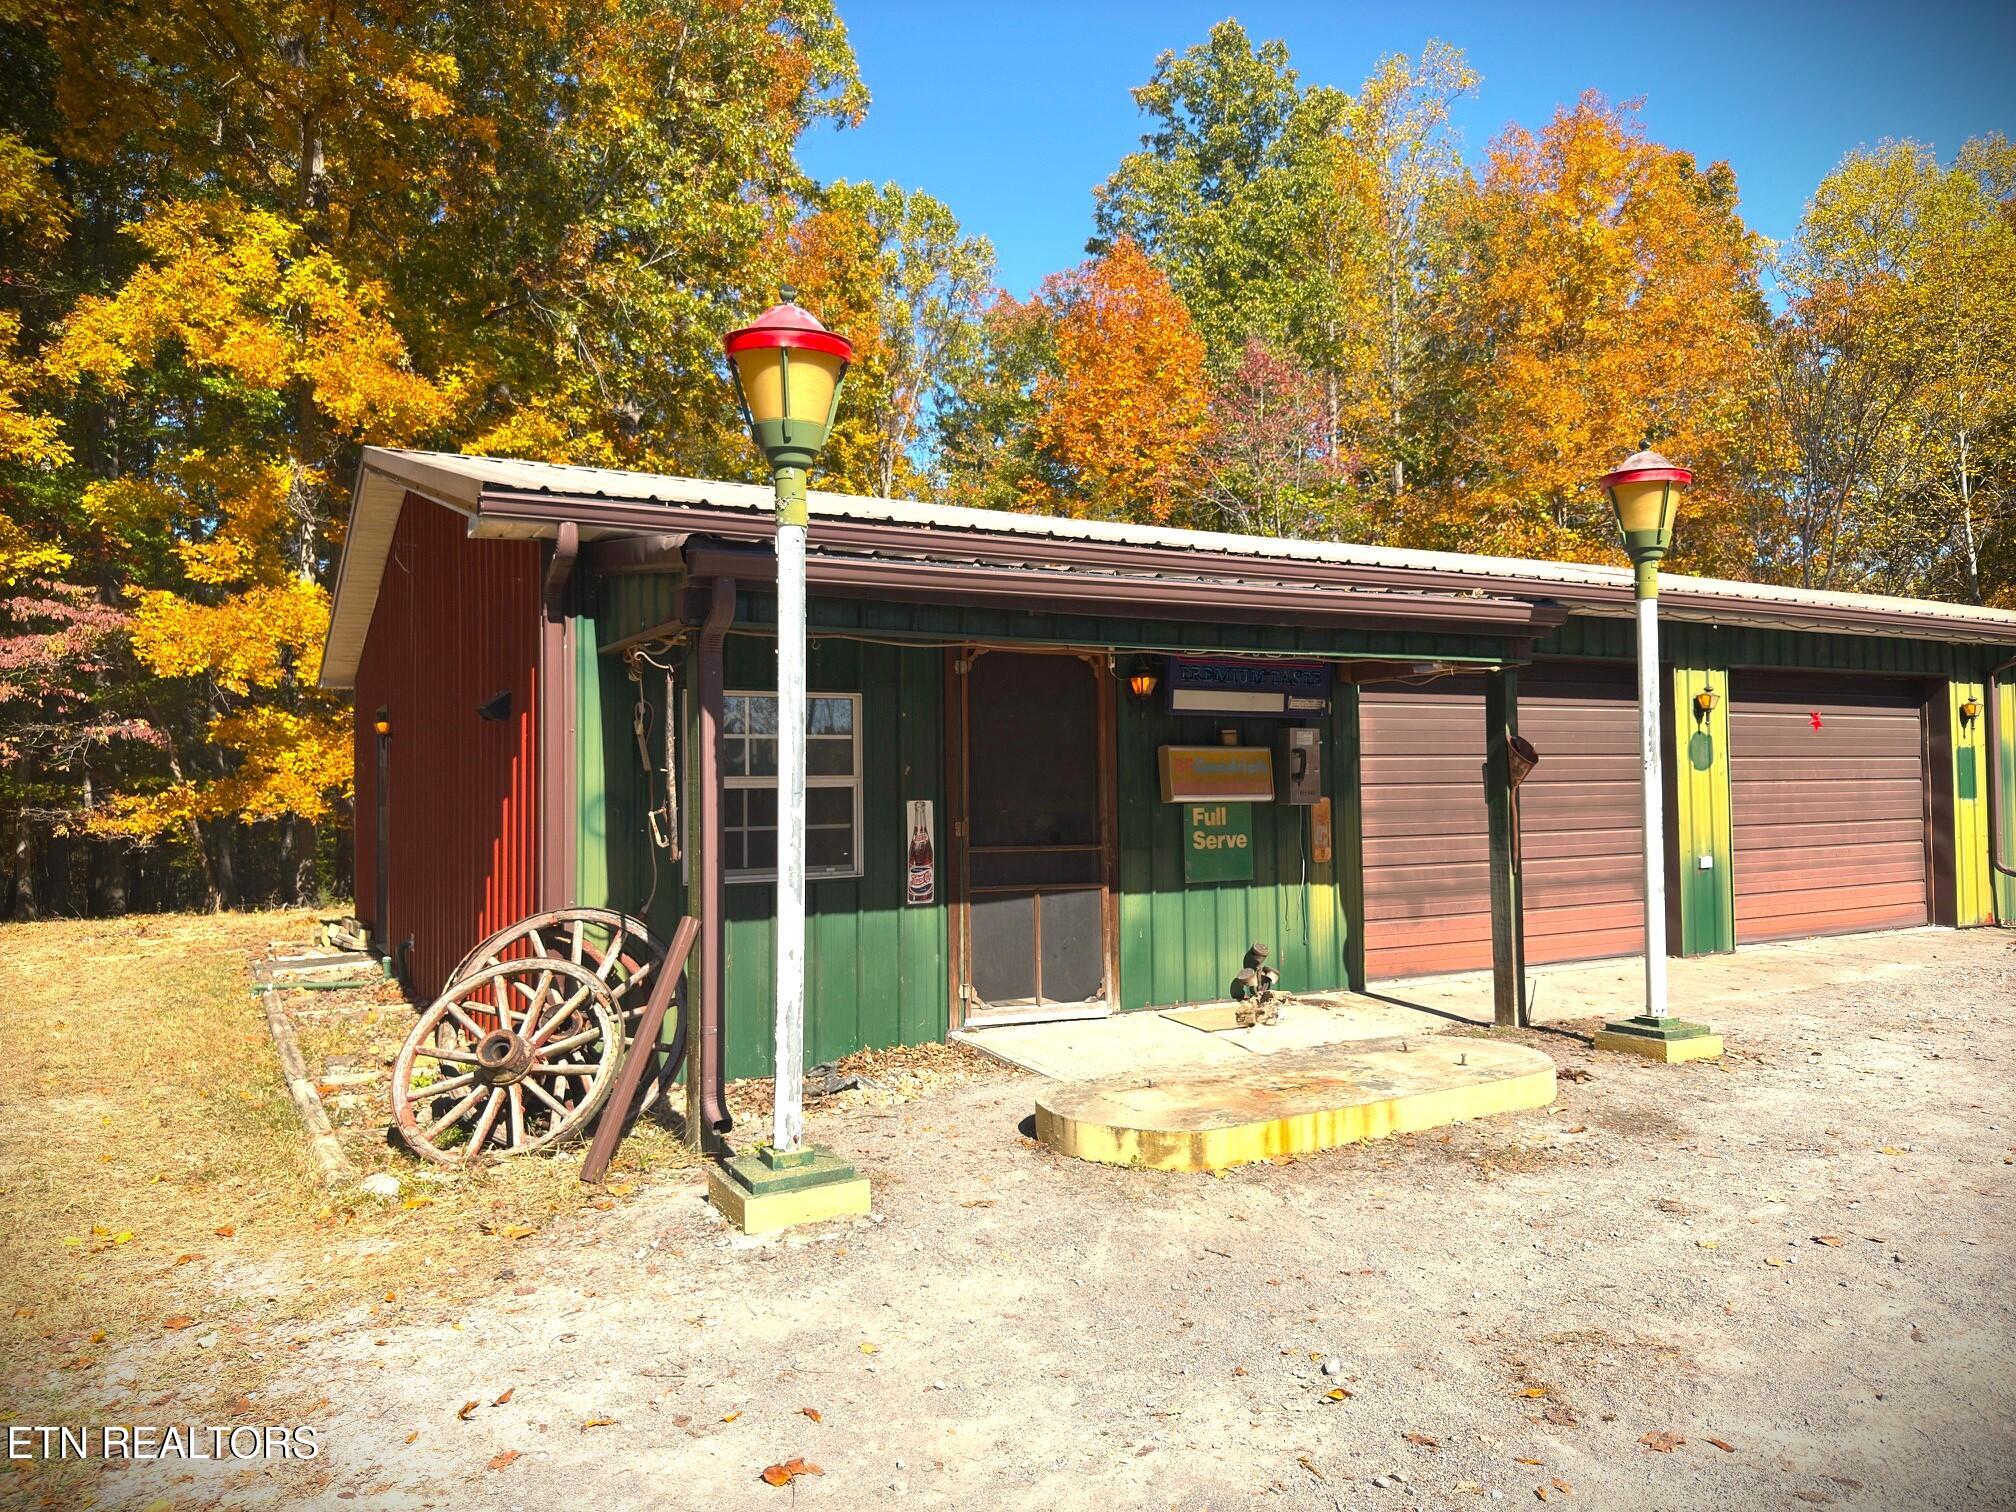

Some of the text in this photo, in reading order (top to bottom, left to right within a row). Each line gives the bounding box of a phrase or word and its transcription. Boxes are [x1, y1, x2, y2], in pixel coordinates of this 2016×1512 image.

[1179, 665, 1265, 685] PREMIUM
[1192, 807, 1227, 826] Full
[1192, 830, 1249, 849] Serve
